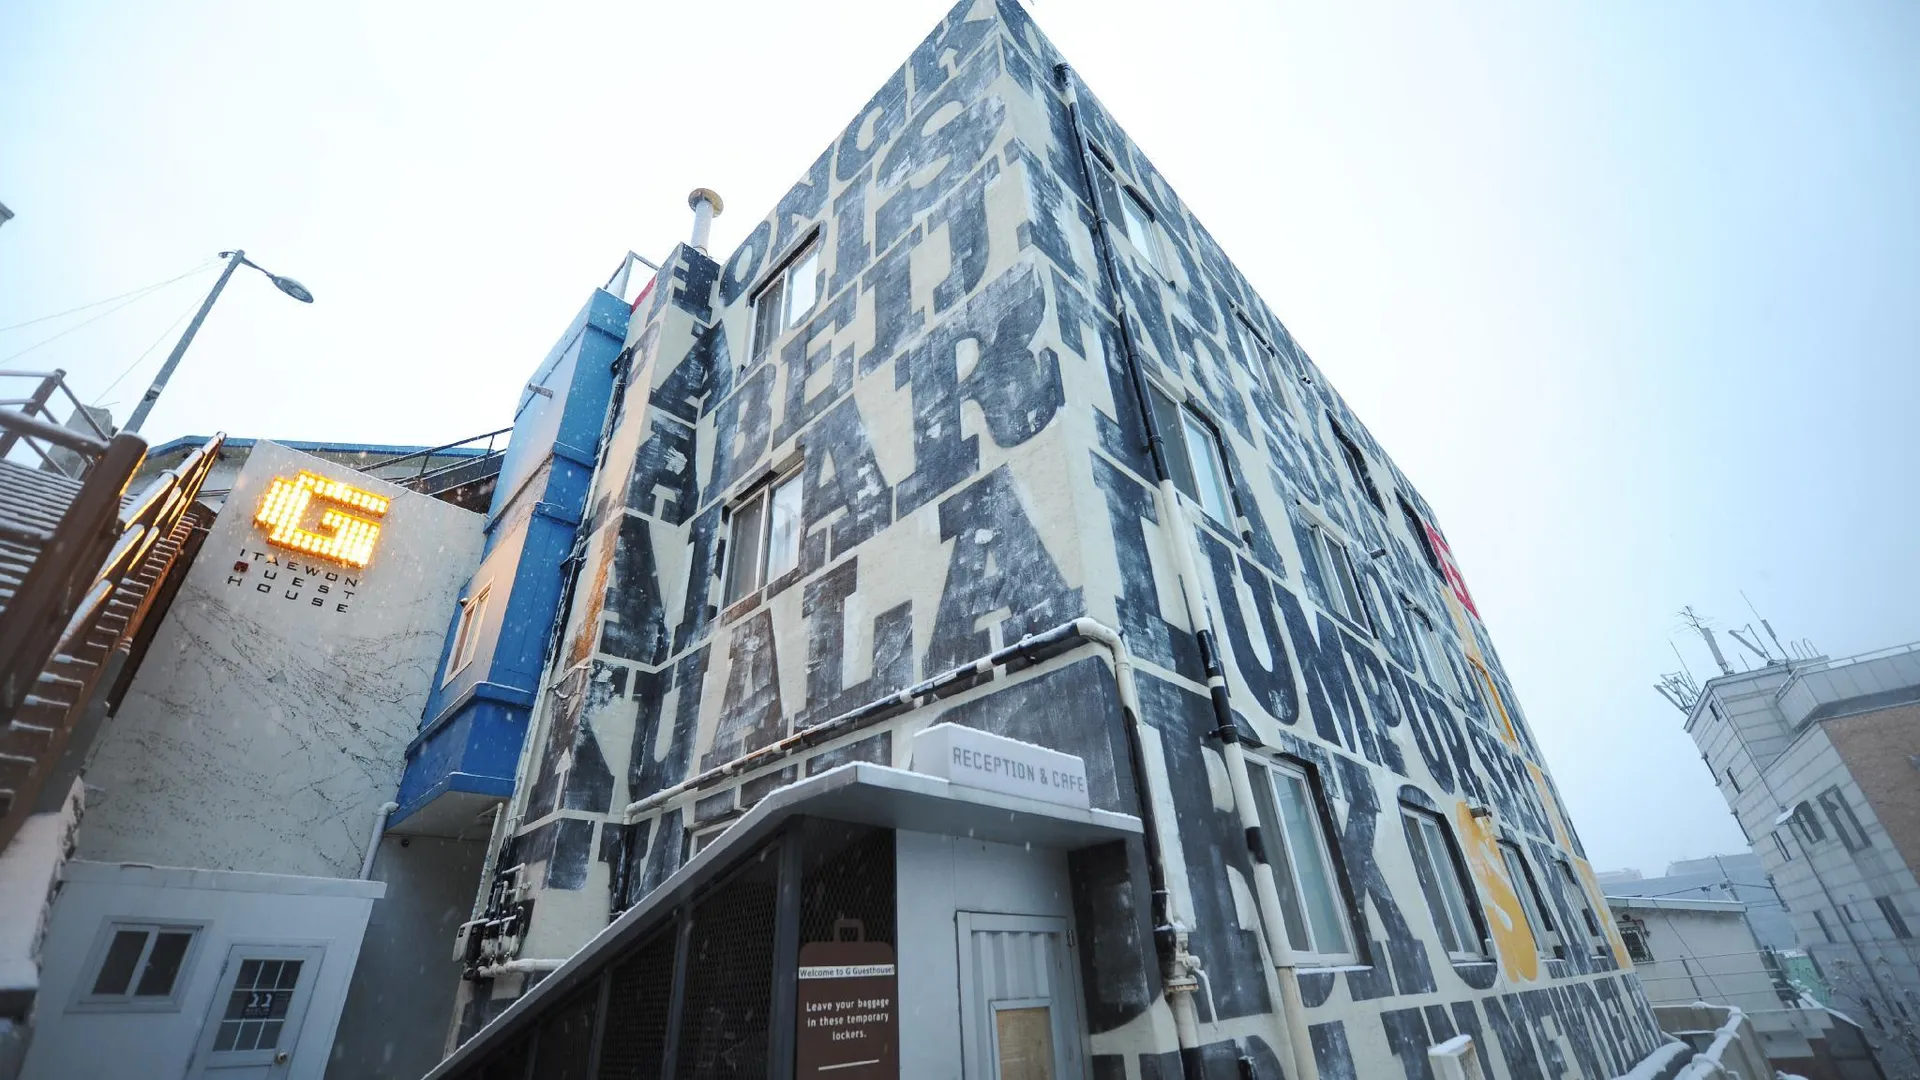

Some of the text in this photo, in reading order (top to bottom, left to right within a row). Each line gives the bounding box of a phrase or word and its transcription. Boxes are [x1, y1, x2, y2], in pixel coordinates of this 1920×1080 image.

[240, 549, 358, 588] ITAEWON
[227, 576, 348, 613] HOUSE
[953, 747, 1085, 792] RECEPTION & CAFE
[800, 969, 834, 977] Welcome
[806, 998, 889, 1012] Leave your baggage
[807, 1013, 889, 1027] in these temporary
[832, 1030, 867, 1040] lockers.
